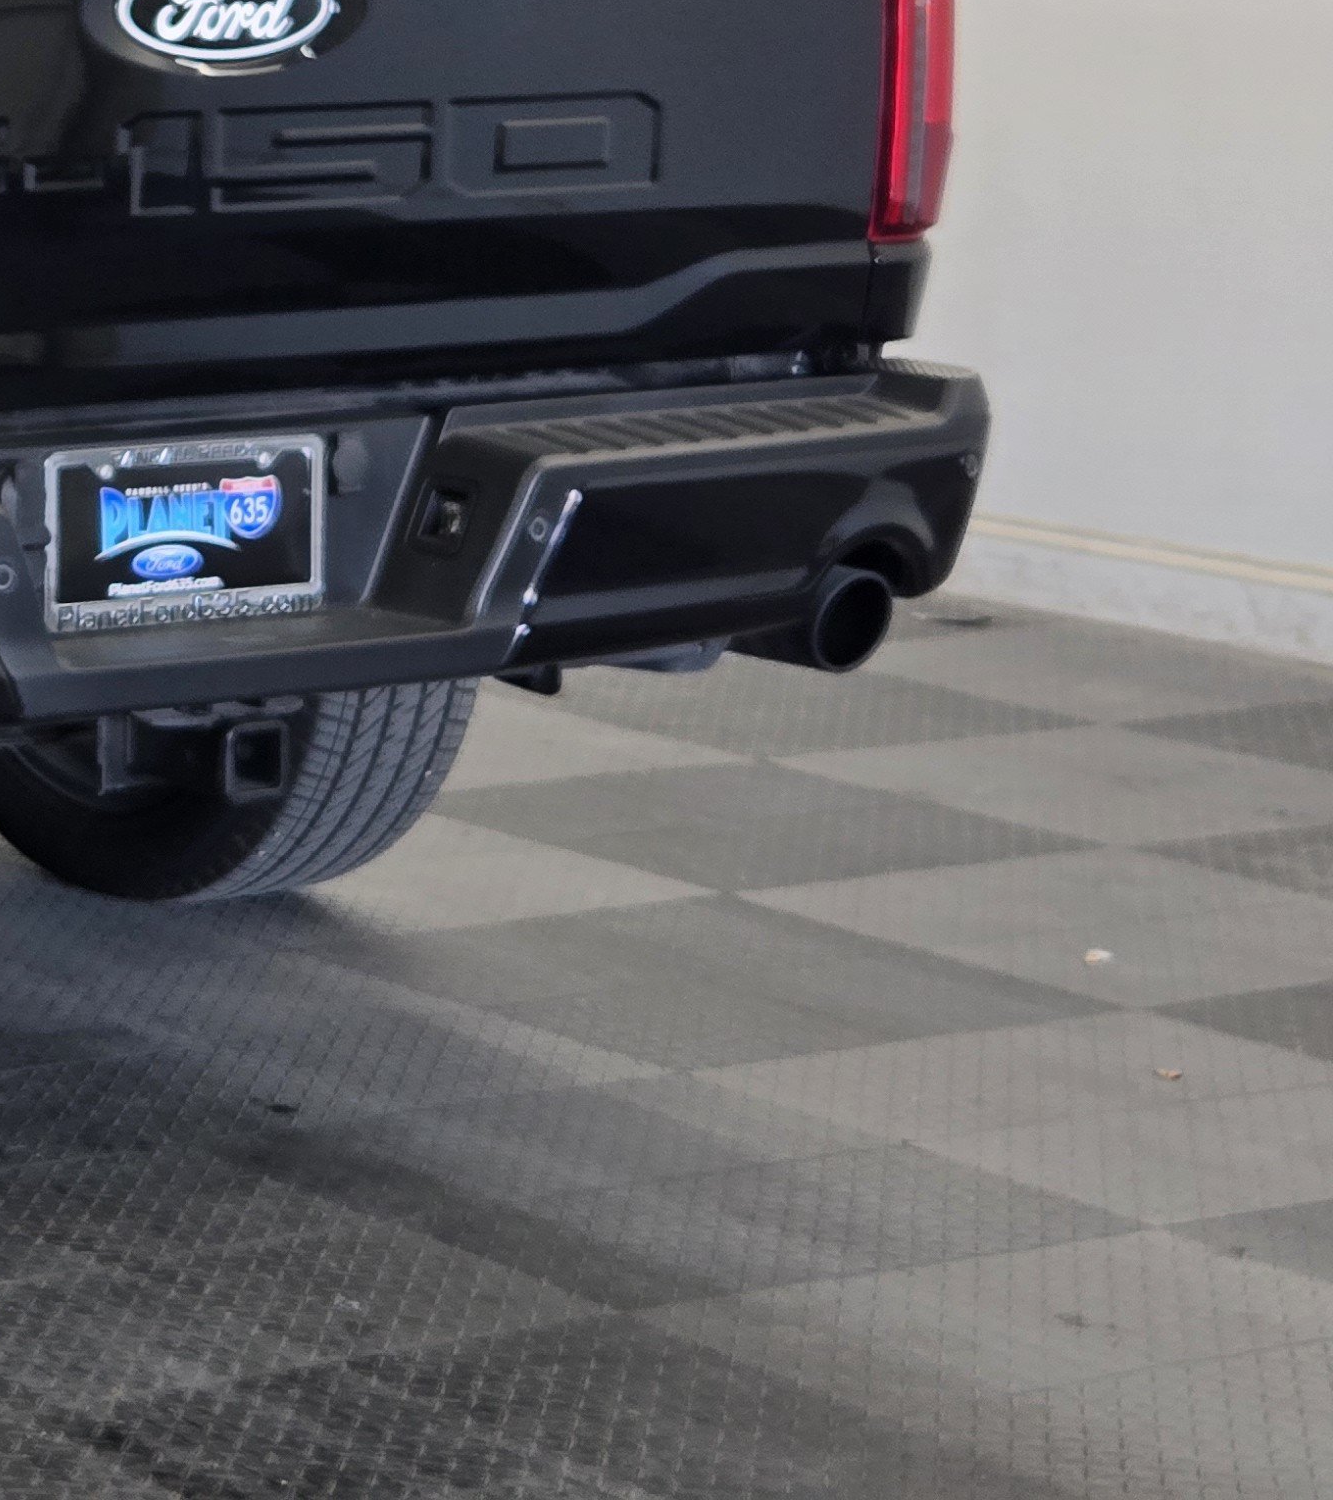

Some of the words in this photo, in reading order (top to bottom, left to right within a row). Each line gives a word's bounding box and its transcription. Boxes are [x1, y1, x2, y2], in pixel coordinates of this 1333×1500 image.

[100, 486, 231, 551] PLANET
[230, 495, 269, 526] 635
[145, 551, 185, 572] Ford
